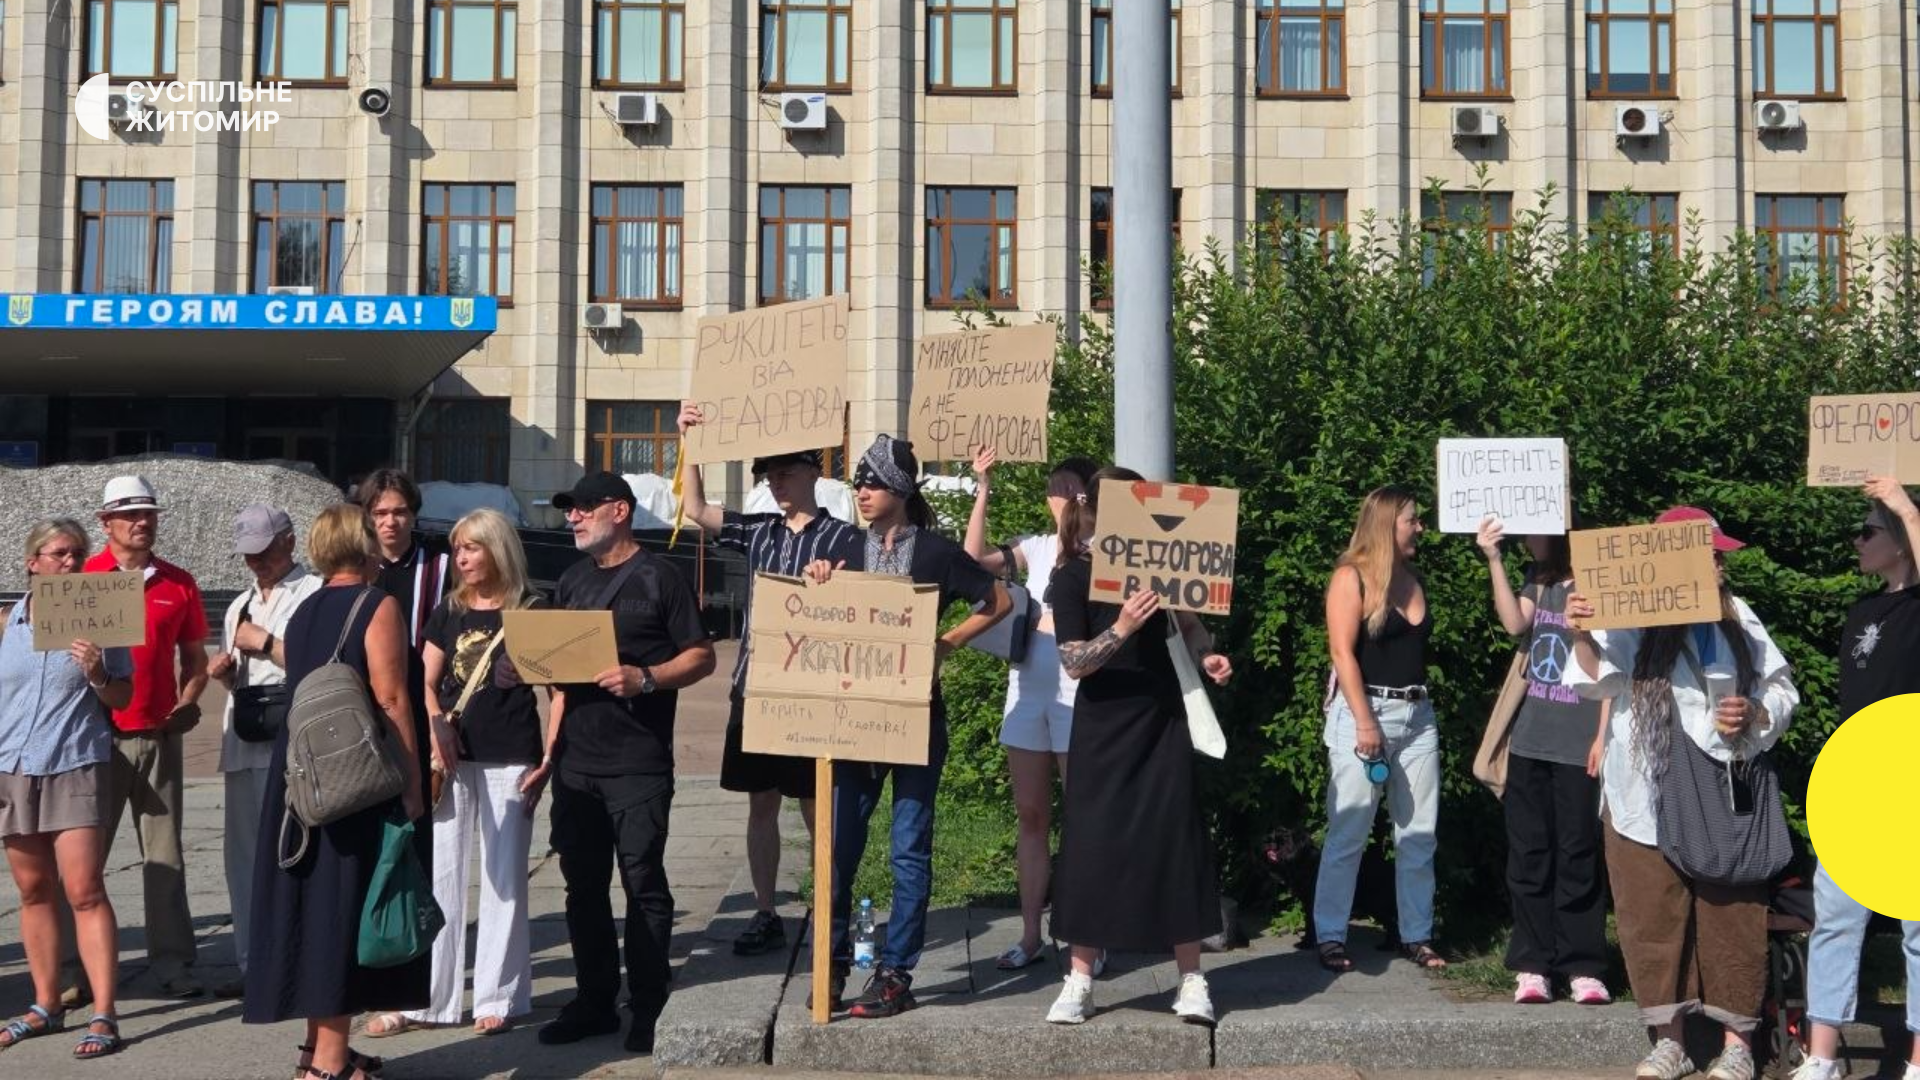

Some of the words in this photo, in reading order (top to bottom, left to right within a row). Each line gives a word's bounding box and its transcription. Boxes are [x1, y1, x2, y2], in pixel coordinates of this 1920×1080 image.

[65, 299, 238, 323] ГЕРОЯМ
[265, 300, 424, 325] СЛАВА!
[917, 333, 992, 370] МІНЯЙТЕ
[752, 359, 794, 388] ВІД
[919, 395, 931, 416] А
[936, 392, 956, 414] НЕ
[928, 413, 1044, 461] ФЕДОРОВА
[1447, 449, 1562, 479] ПОВЕРНІТЬ
[1450, 484, 1563, 522] ФЕДОРОВА!
[1100, 534, 1234, 578] ФЕДОРОВА
[1597, 534, 1624, 562] НЕ
[1628, 523, 1713, 557] РУЙНУЙТЕ
[40, 577, 138, 598] ПРАЦЮЄ
[74, 596, 97, 611] НЕ
[1150, 576, 1231, 611] МО!!!
[1600, 580, 1700, 618] ПРАЦЮЄ!
[40, 607, 125, 635] ЧІПАЙ!
